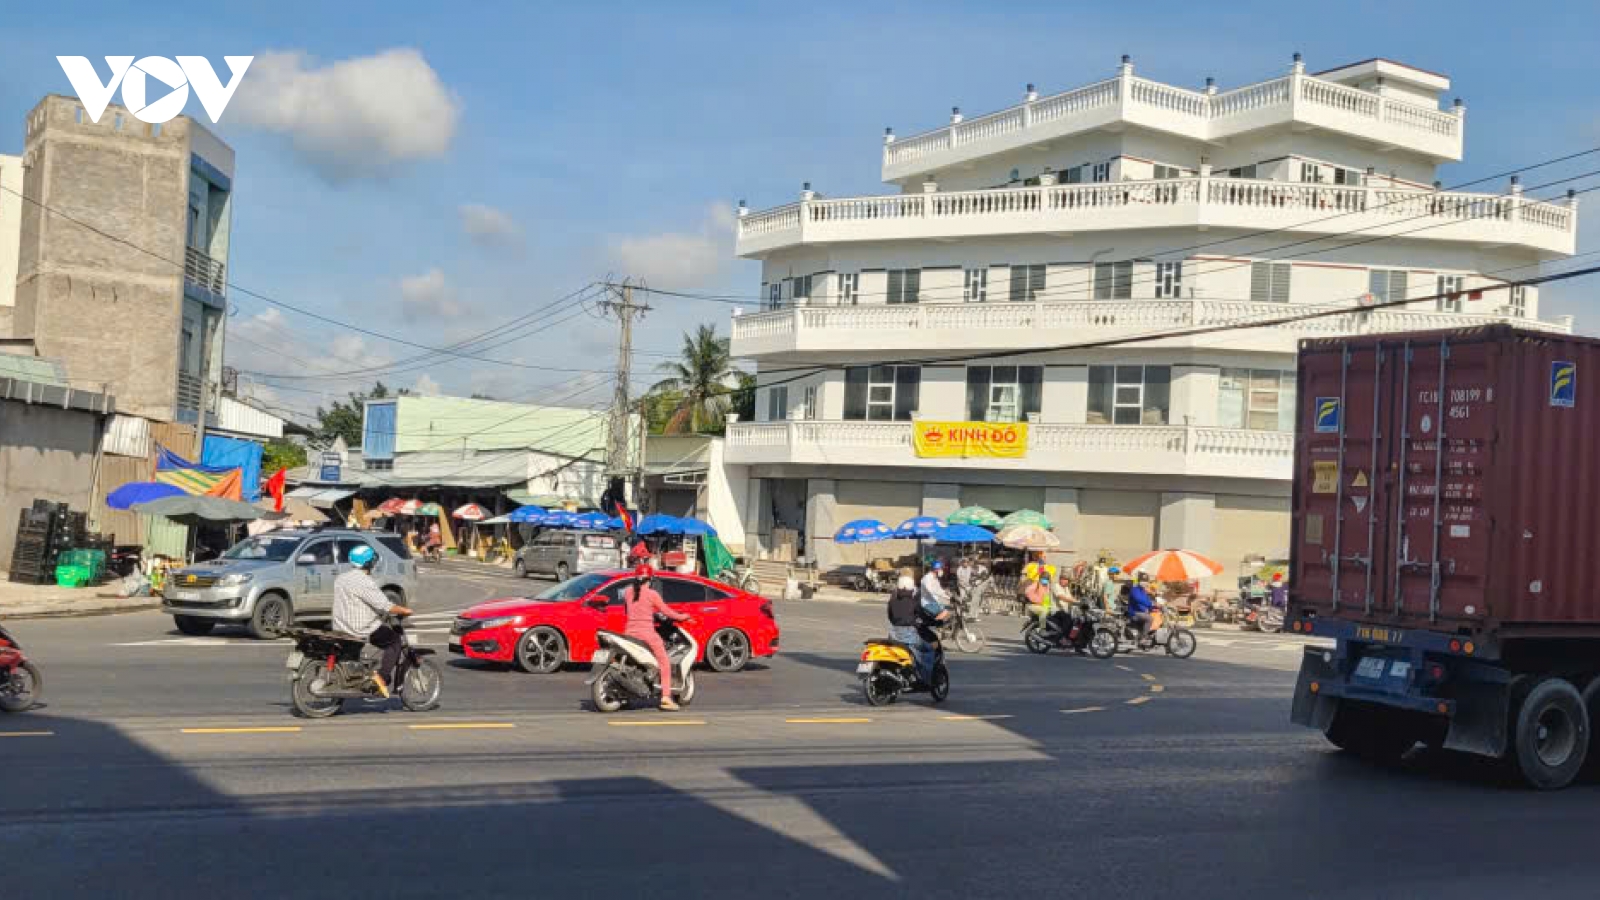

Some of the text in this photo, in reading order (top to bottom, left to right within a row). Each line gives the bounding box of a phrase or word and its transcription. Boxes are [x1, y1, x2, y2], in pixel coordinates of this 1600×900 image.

[1450, 389, 1480, 403] 708199
[947, 426, 1017, 443] KINH ĐÔ
